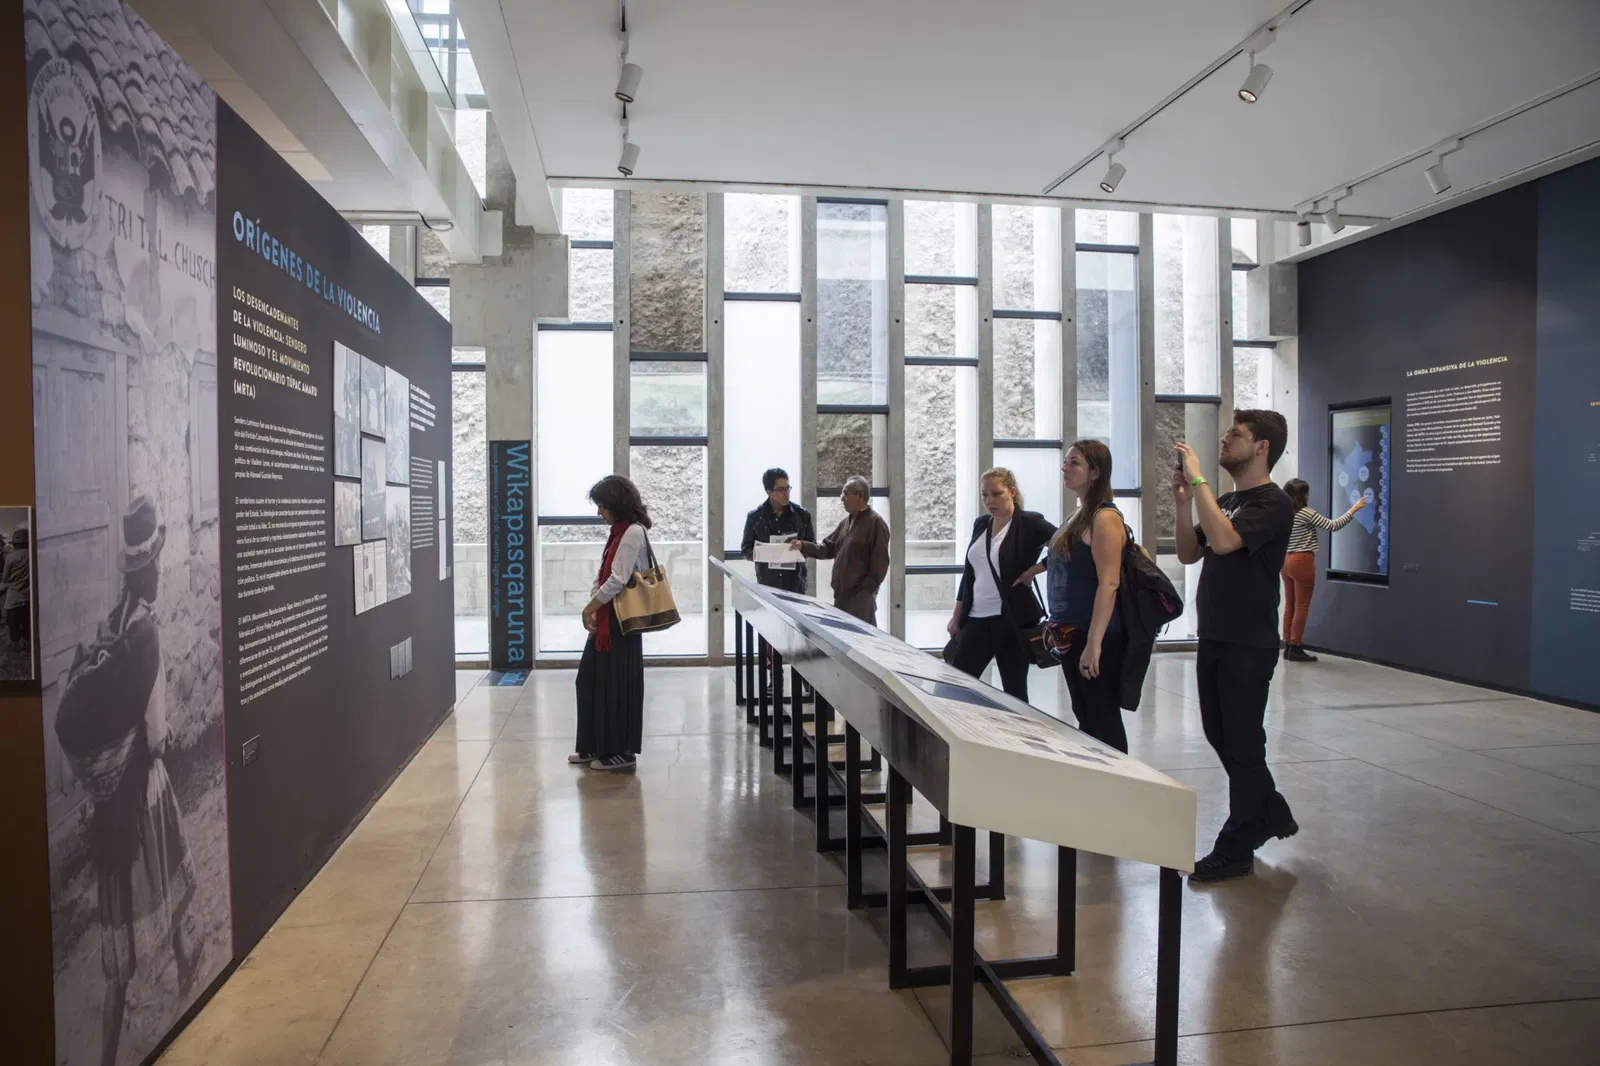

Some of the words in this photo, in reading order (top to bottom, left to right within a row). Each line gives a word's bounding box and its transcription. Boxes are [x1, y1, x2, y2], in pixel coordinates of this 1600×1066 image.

[233, 211, 302, 282] ORÍGENES
[306, 262, 320, 294] DE
[324, 276, 335, 304] LA
[337, 285, 380, 334] VIOLENCIA
[233, 286, 245, 302] LOS
[246, 293, 299, 331] DESENCADENANTES
[234, 309, 242, 324] DE
[243, 314, 251, 328] LA
[252, 319, 285, 344] VIOLENCIA:
[286, 335, 307, 354] SENDERO
[234, 333, 266, 357] LUMINOSO
[267, 348, 272, 360] Y
[272, 350, 278, 362] EL
[280, 354, 310, 375] MOVIMIENTO
[1429, 364, 1458, 374] EXPANSIVA
[1475, 356, 1508, 366] VIOLENCIA
[234, 356, 286, 386] REVOLUCIONARIO
[286, 374, 302, 392] TÚPAC
[302, 383, 318, 396] AMARU
[234, 379, 256, 399] (MRTA)
[501, 442, 529, 664] Wikapasqaruna
